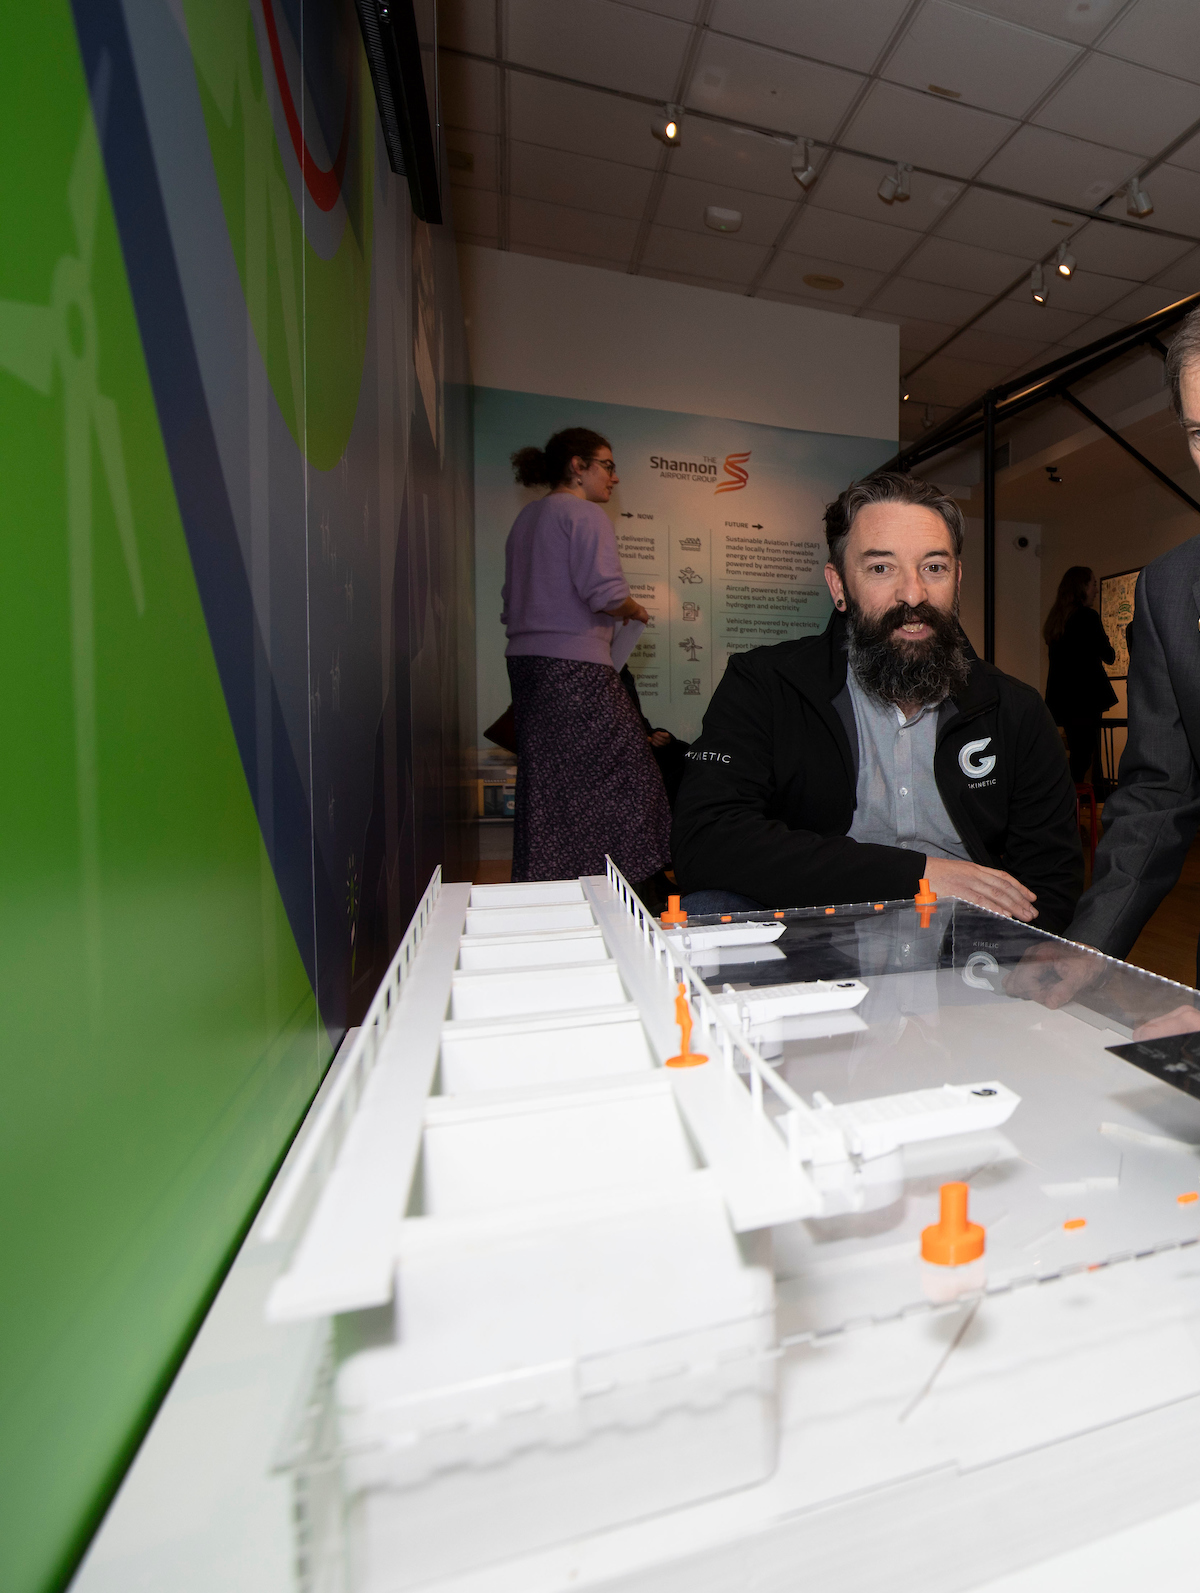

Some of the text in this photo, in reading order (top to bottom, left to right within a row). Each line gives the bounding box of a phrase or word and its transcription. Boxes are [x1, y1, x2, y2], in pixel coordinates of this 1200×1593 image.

[703, 456, 717, 464] THE
[650, 456, 718, 476] Shannon
[660, 471, 717, 484] AIRPORT GROUP
[725, 521, 749, 529] FUTURE
[621, 535, 655, 545] delivering
[725, 536, 762, 544] Sustainable
[625, 544, 655, 552] powered
[745, 545, 765, 553] locally
[782, 548, 814, 556] renewable
[757, 555, 793, 563] transported
[743, 570, 775, 578] renewable
[758, 627, 788, 635] hydrogen
